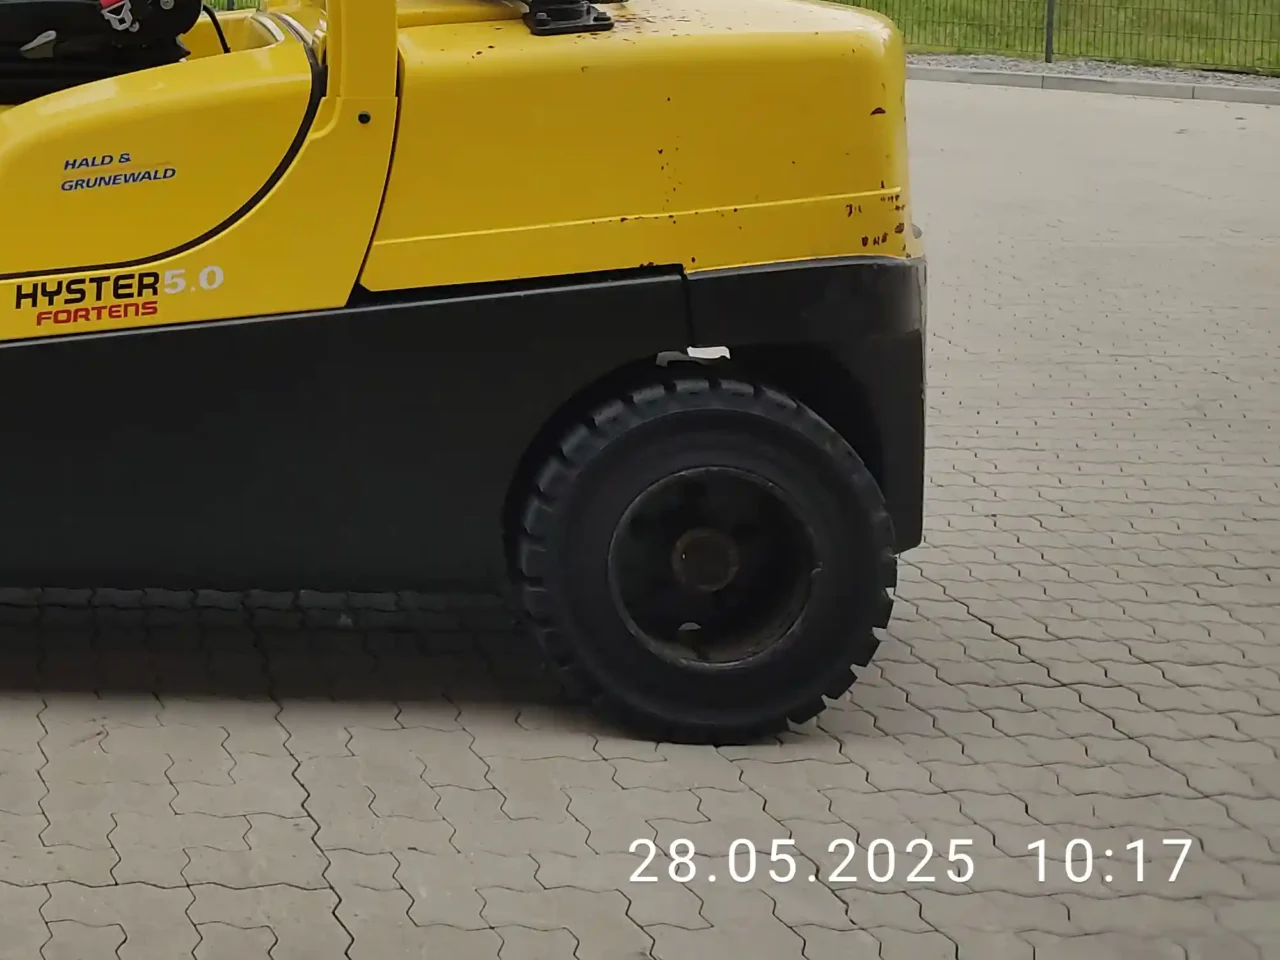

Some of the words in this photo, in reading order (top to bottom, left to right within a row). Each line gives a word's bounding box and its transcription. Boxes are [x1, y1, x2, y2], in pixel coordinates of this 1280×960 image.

[64, 155, 113, 170] HALD
[118, 153, 131, 163] &
[61, 168, 176, 191] GRUNEWALD
[15, 271, 159, 309] HYSTER
[163, 265, 225, 295] 5.0
[36, 300, 159, 327] FORTENS
